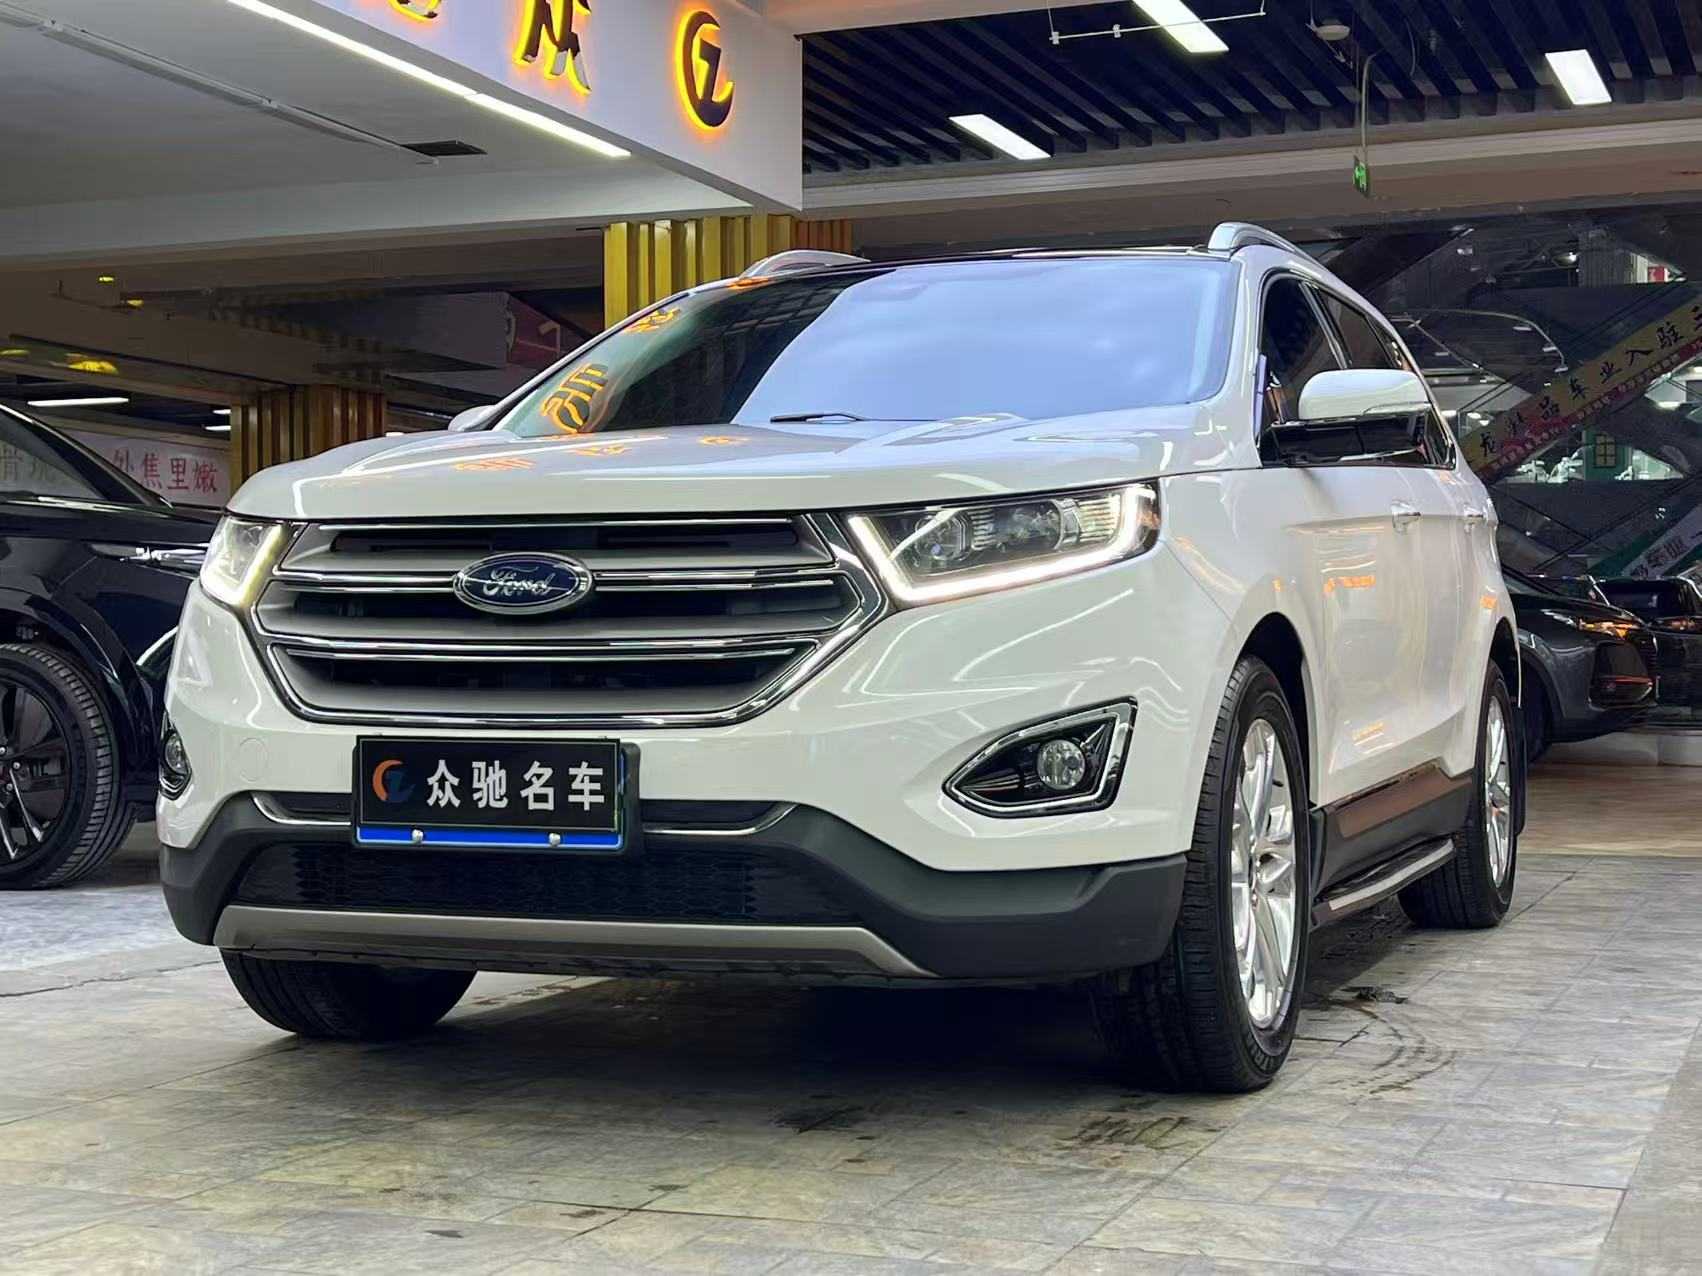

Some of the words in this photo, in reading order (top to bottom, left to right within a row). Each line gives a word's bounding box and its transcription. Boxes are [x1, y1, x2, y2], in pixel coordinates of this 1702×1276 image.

[483, 567, 556, 596] Ford
[426, 759, 605, 811] 众驰名车
